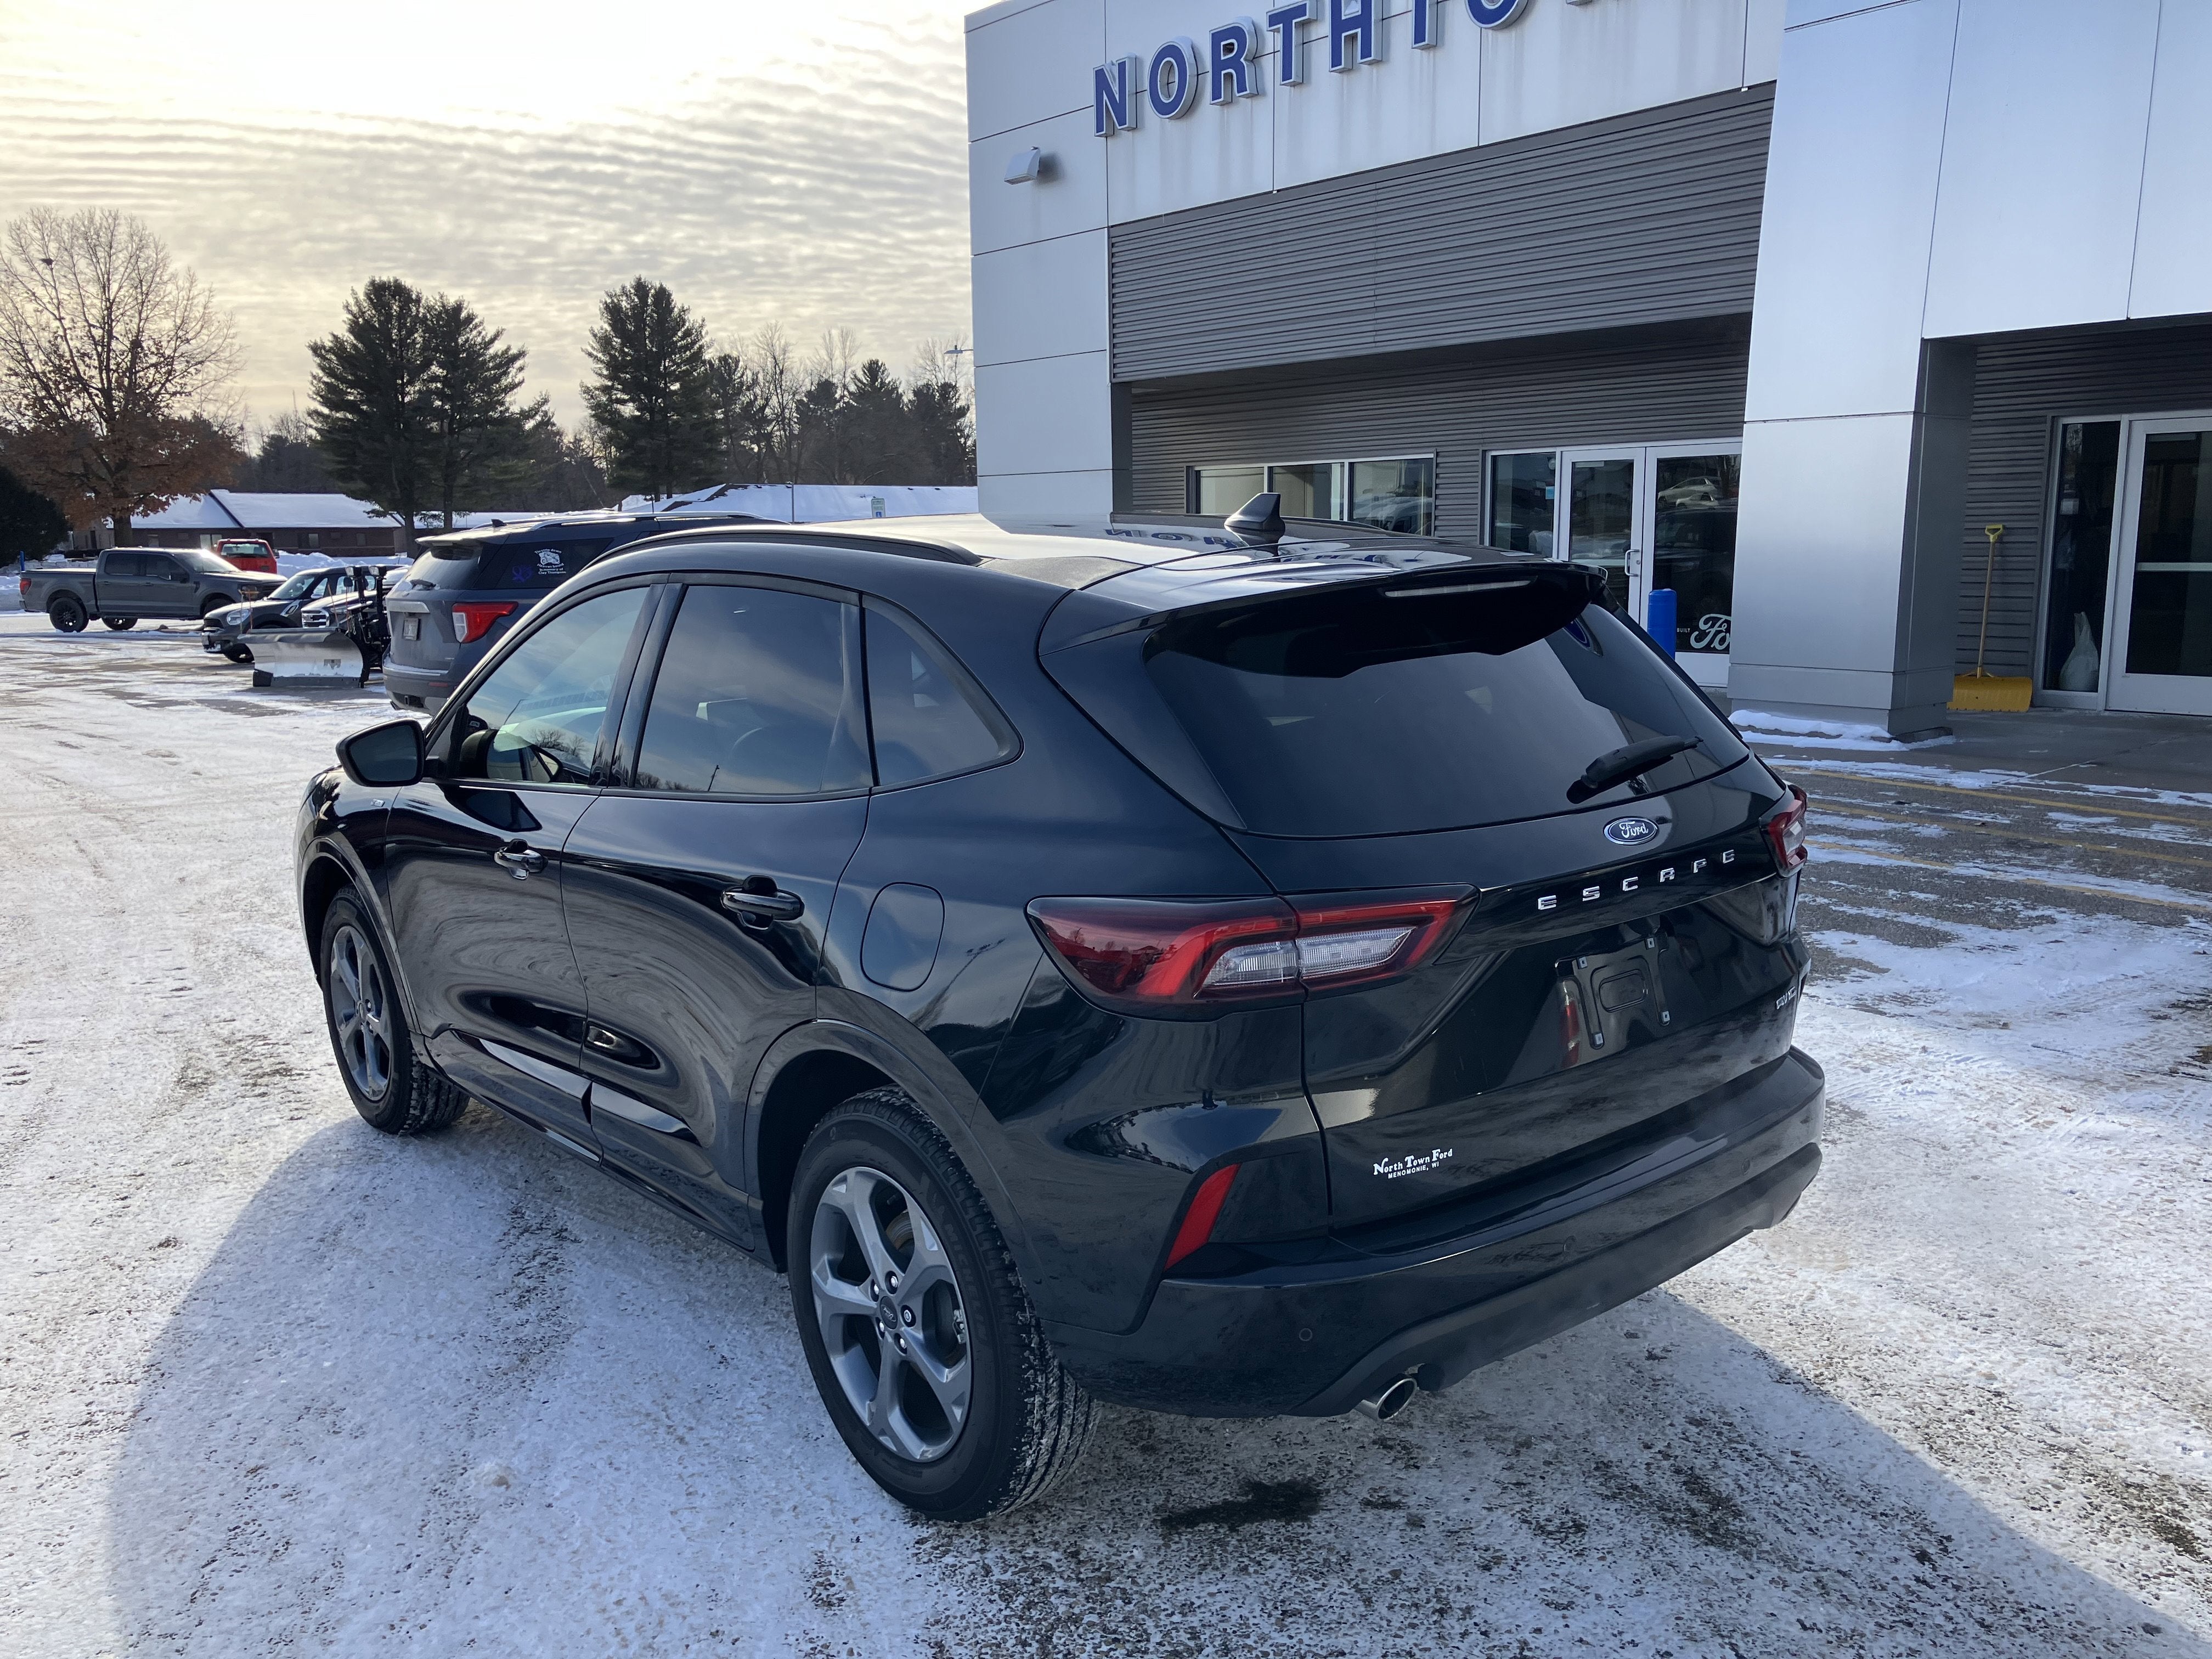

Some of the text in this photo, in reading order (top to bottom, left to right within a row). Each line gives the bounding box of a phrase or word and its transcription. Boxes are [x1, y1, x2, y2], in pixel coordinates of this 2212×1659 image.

[1619, 821, 1649, 838] Ford
[1537, 849, 1735, 911] ESCAPE
[1373, 1148, 1453, 1175] North Town Ford
[1388, 1164, 1429, 1179] MENOMONIE,
